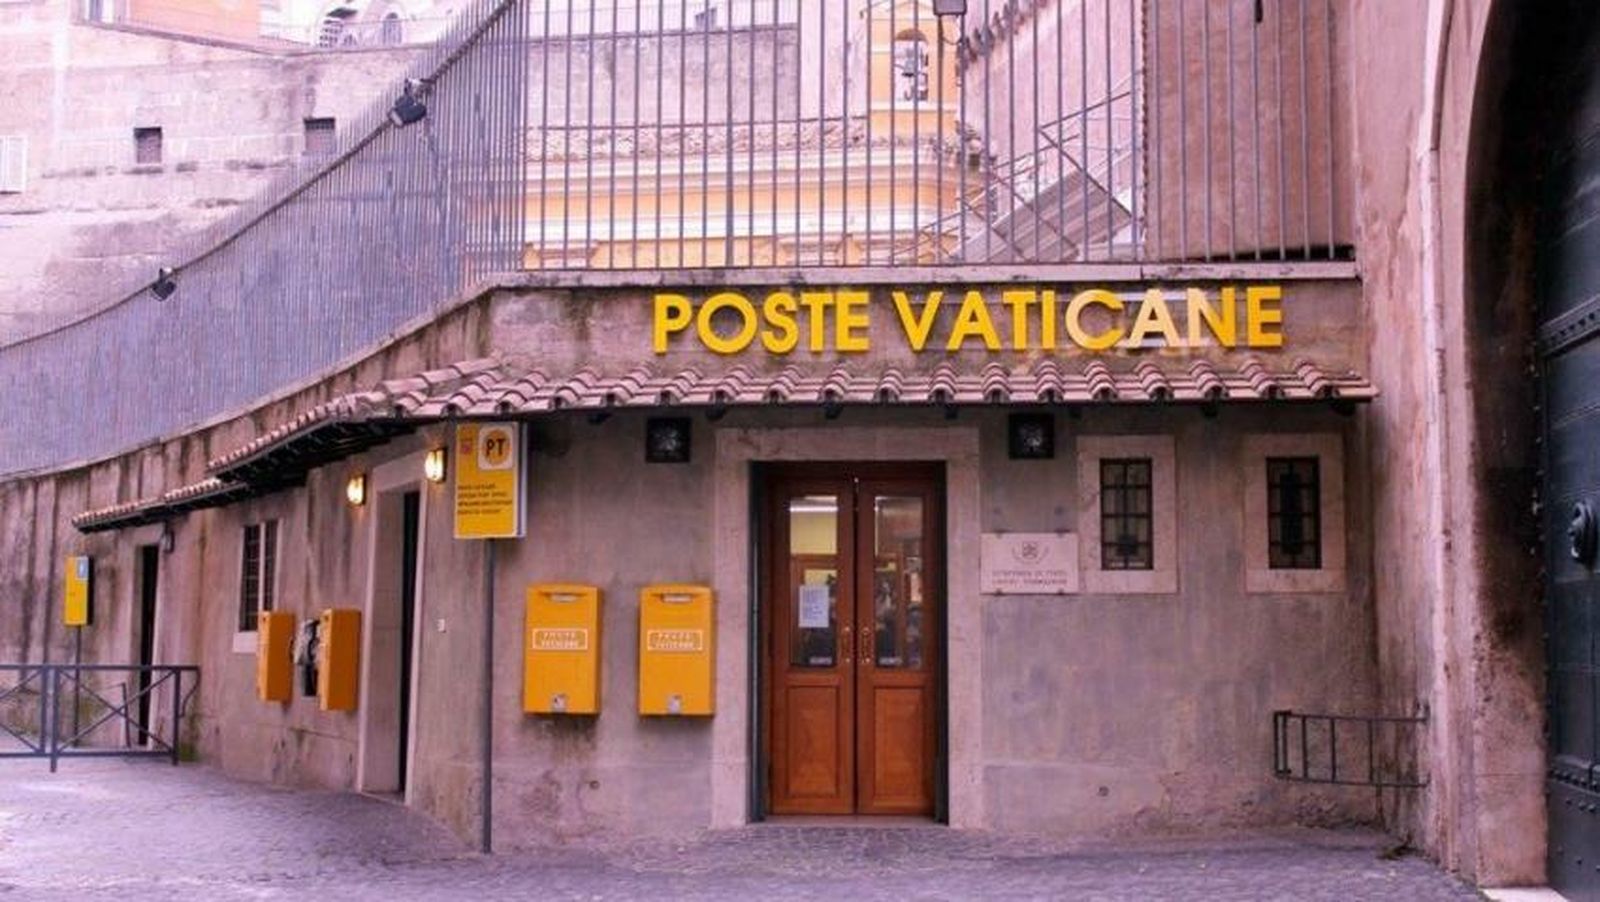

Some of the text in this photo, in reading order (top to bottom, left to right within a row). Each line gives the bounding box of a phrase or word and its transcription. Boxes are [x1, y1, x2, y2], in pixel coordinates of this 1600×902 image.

[654, 286, 1283, 354] POSTE VATICANE
[486, 438, 506, 458] PT
